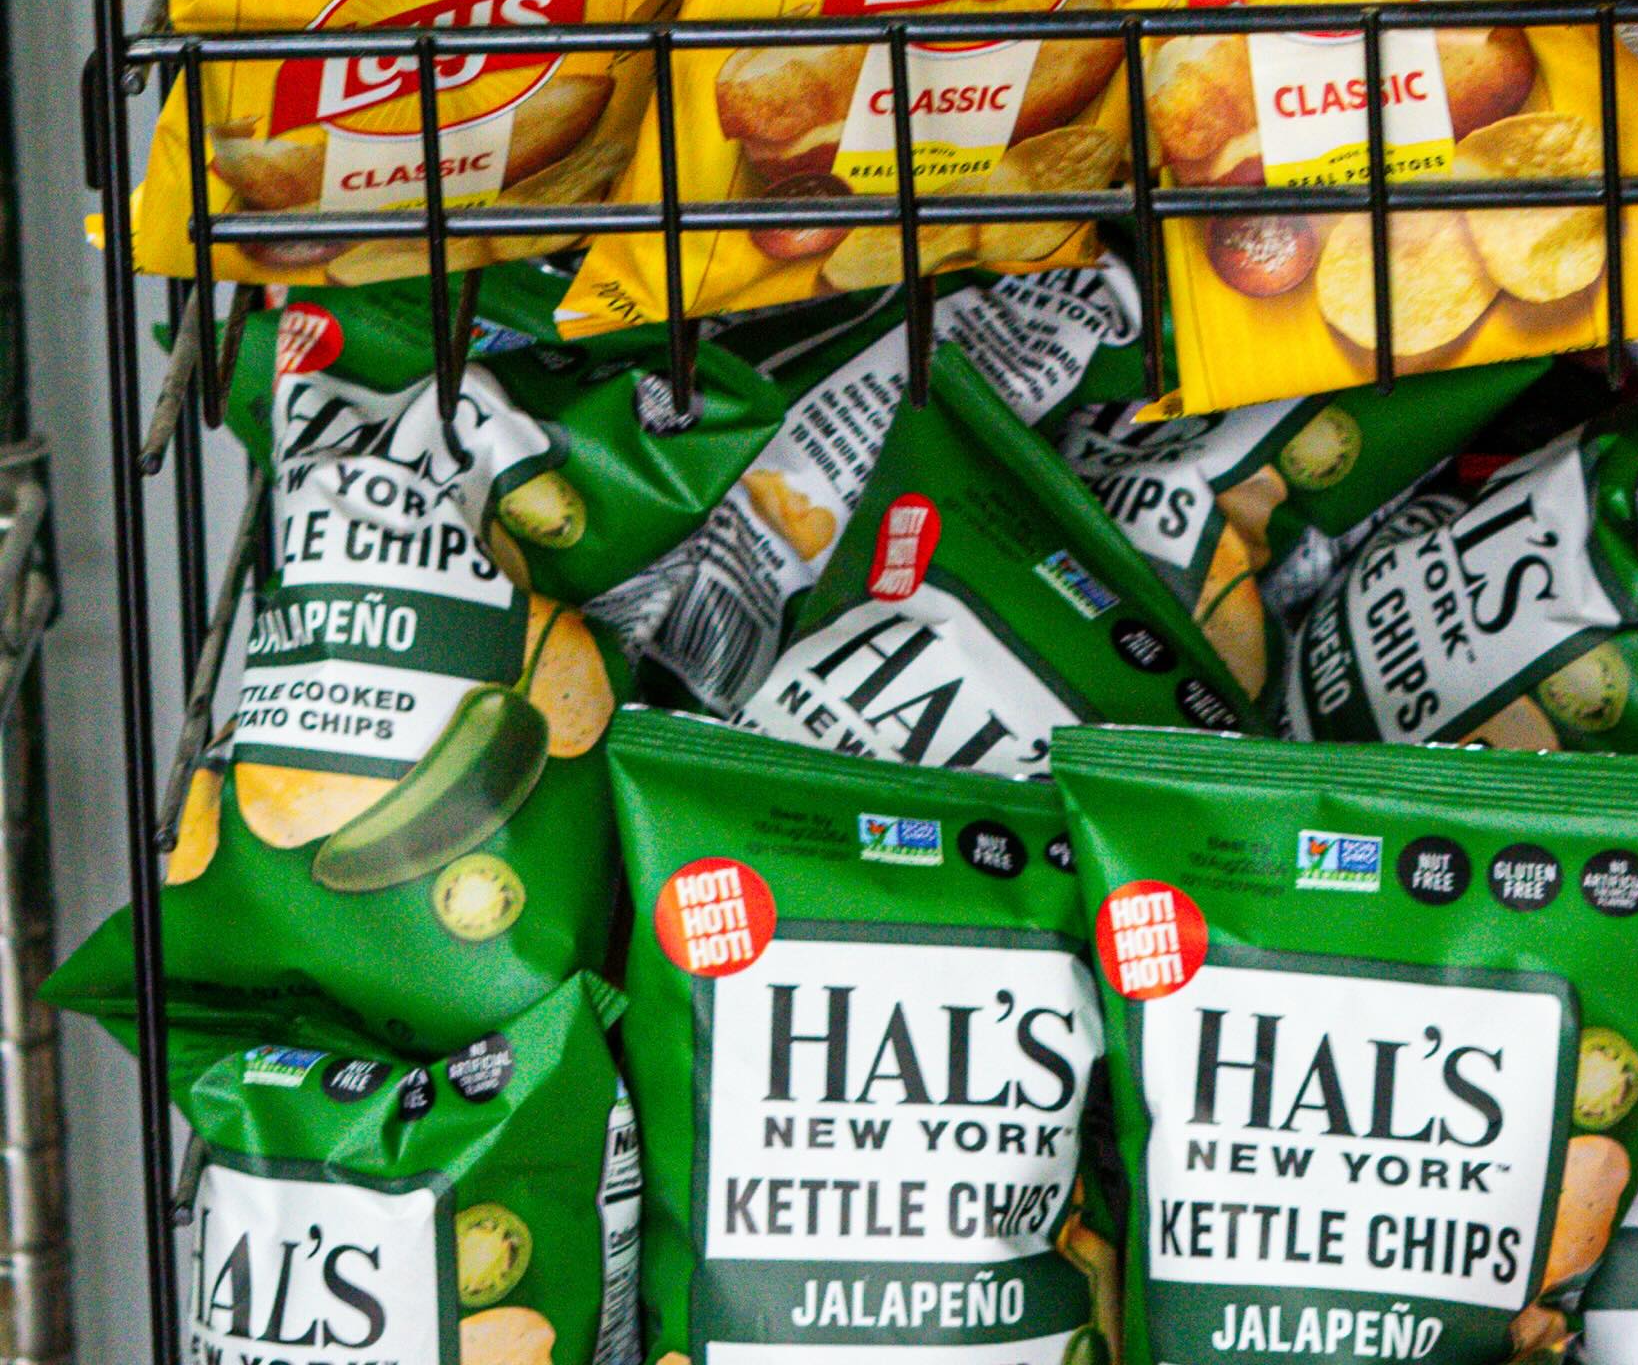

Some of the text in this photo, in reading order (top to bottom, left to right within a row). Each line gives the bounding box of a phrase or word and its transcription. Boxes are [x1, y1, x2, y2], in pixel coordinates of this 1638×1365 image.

[345, 518, 500, 583] CHIPS
[1412, 529, 1470, 662] YORK
[247, 592, 418, 656] JALAPEÑO
[1367, 601, 1440, 733] CHIPS
[288, 677, 416, 712] COOKED
[298, 709, 396, 740] CHIPS
[1411, 869, 1455, 892] FREE
[1417, 853, 1453, 873] NUT
[1492, 859, 1558, 883] GLUTEN
[674, 866, 740, 907] HOT!
[1503, 877, 1544, 901] FREE
[679, 899, 748, 936] HOT!
[1109, 891, 1175, 927] HOT!
[686, 929, 754, 970] HOT!
[1113, 922, 1179, 960] HOT!
[1119, 953, 1185, 994] HOT!
[762, 983, 1078, 1113] HAL'S
[1185, 1006, 1506, 1149] HAL'S
[764, 1116, 1060, 1158] NEW YORK
[1185, 1139, 1495, 1193] NEW YORK
[724, 1176, 1060, 1239] KETTLE CHIPS
[1157, 1197, 1523, 1286] KETTLE CHIPS
[791, 1272, 1026, 1329] JALAPEÑO
[1210, 1303, 1445, 1360] JALAPEÑO
